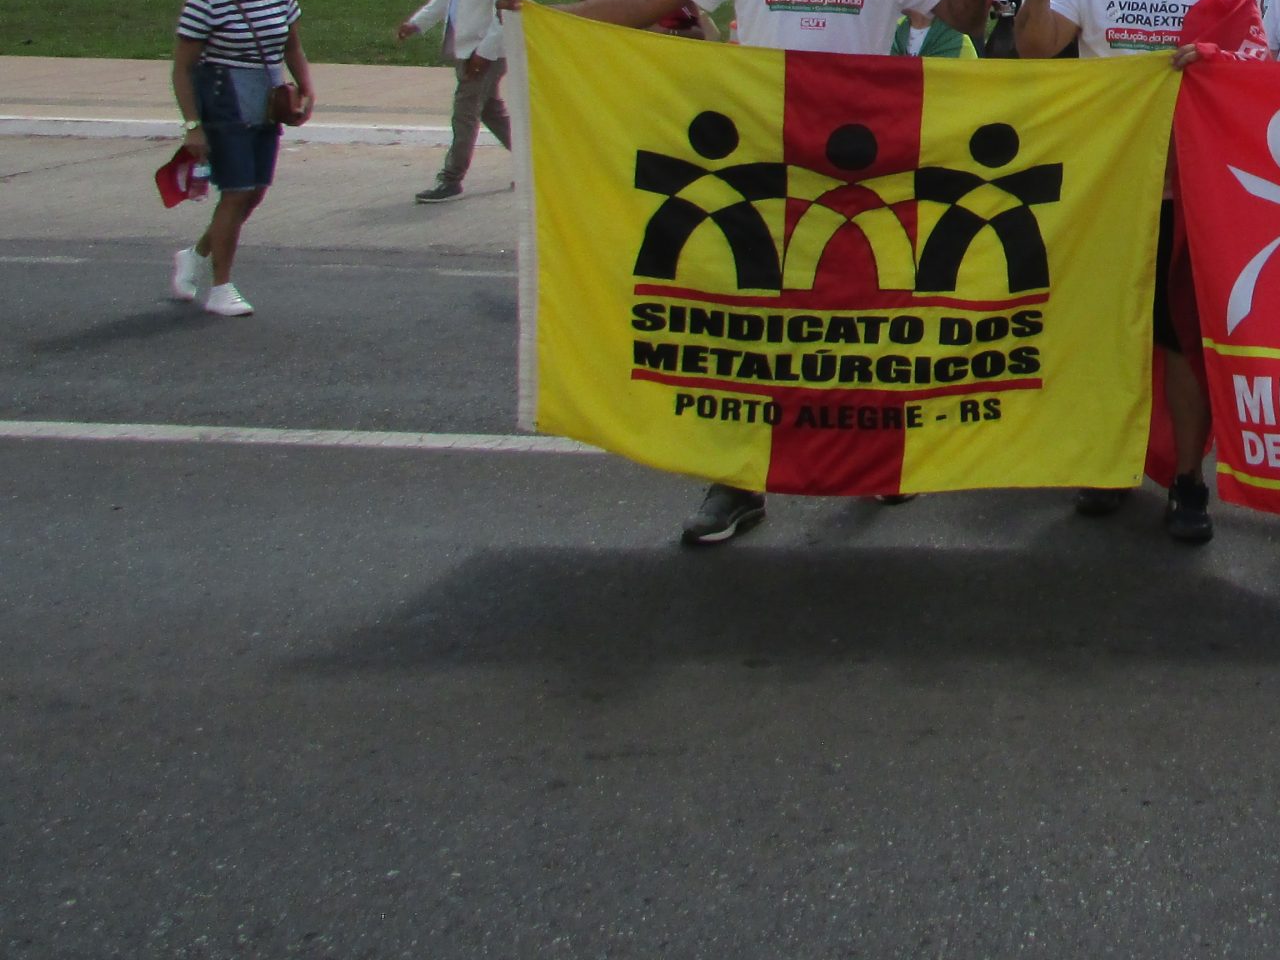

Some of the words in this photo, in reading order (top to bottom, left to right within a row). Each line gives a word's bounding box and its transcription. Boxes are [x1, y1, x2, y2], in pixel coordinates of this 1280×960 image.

[1118, 0, 1147, 12] VIDA
[1149, 0, 1179, 14] NÃO
[801, 17, 826, 28] CUT
[1116, 14, 1152, 27] HORA
[1154, 15, 1184, 27] EXTR
[1108, 29, 1147, 42] Redução
[1149, 32, 1161, 42] da
[631, 302, 925, 345] SINDICATO
[938, 309, 1044, 346] DOS
[632, 340, 1041, 385] METALÚRGICOS
[674, 392, 782, 426] PORTO
[791, 403, 924, 431] ALEGRE
[960, 398, 1002, 423] RS
